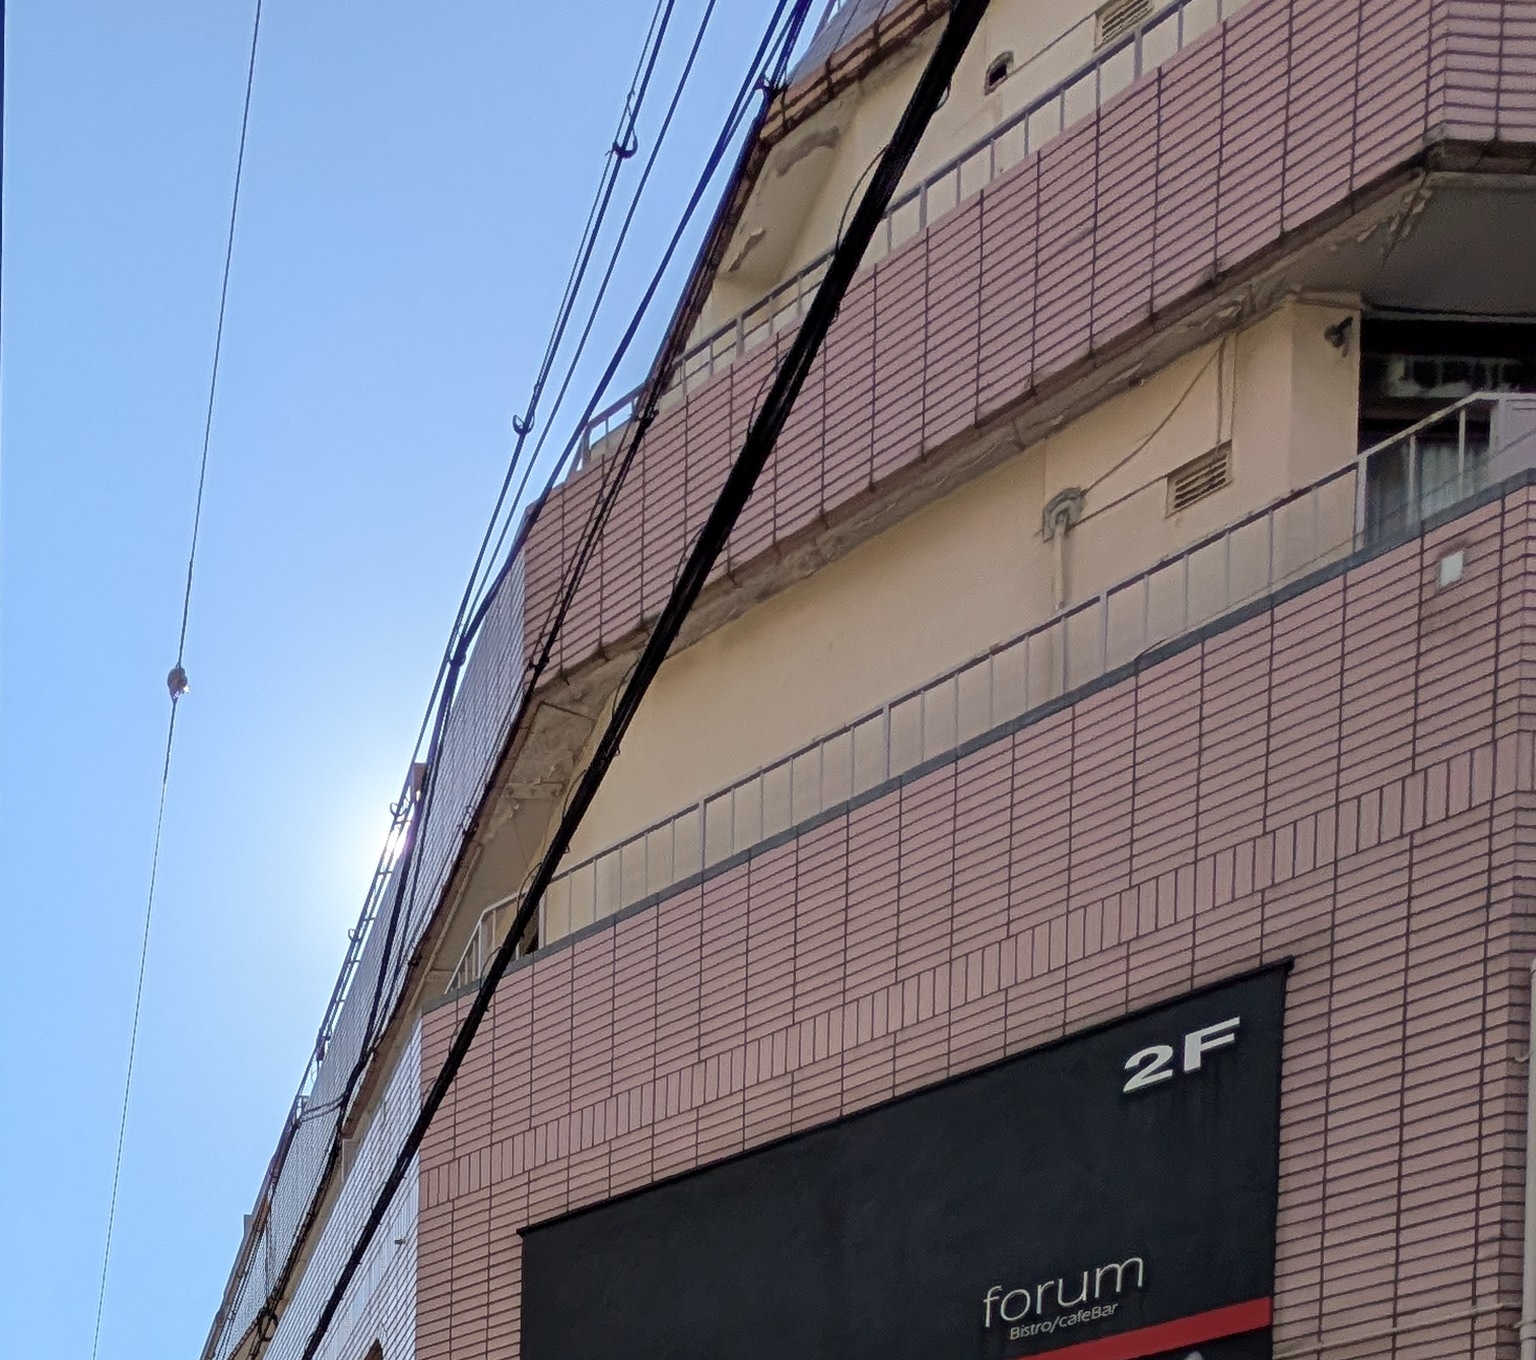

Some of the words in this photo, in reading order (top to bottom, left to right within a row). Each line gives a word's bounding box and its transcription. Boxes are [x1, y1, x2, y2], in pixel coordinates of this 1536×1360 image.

[1122, 1016, 1241, 1093] 2F
[983, 1257, 1144, 1328] forum
[1009, 1303, 1119, 1340] Bistro/cafeBar
